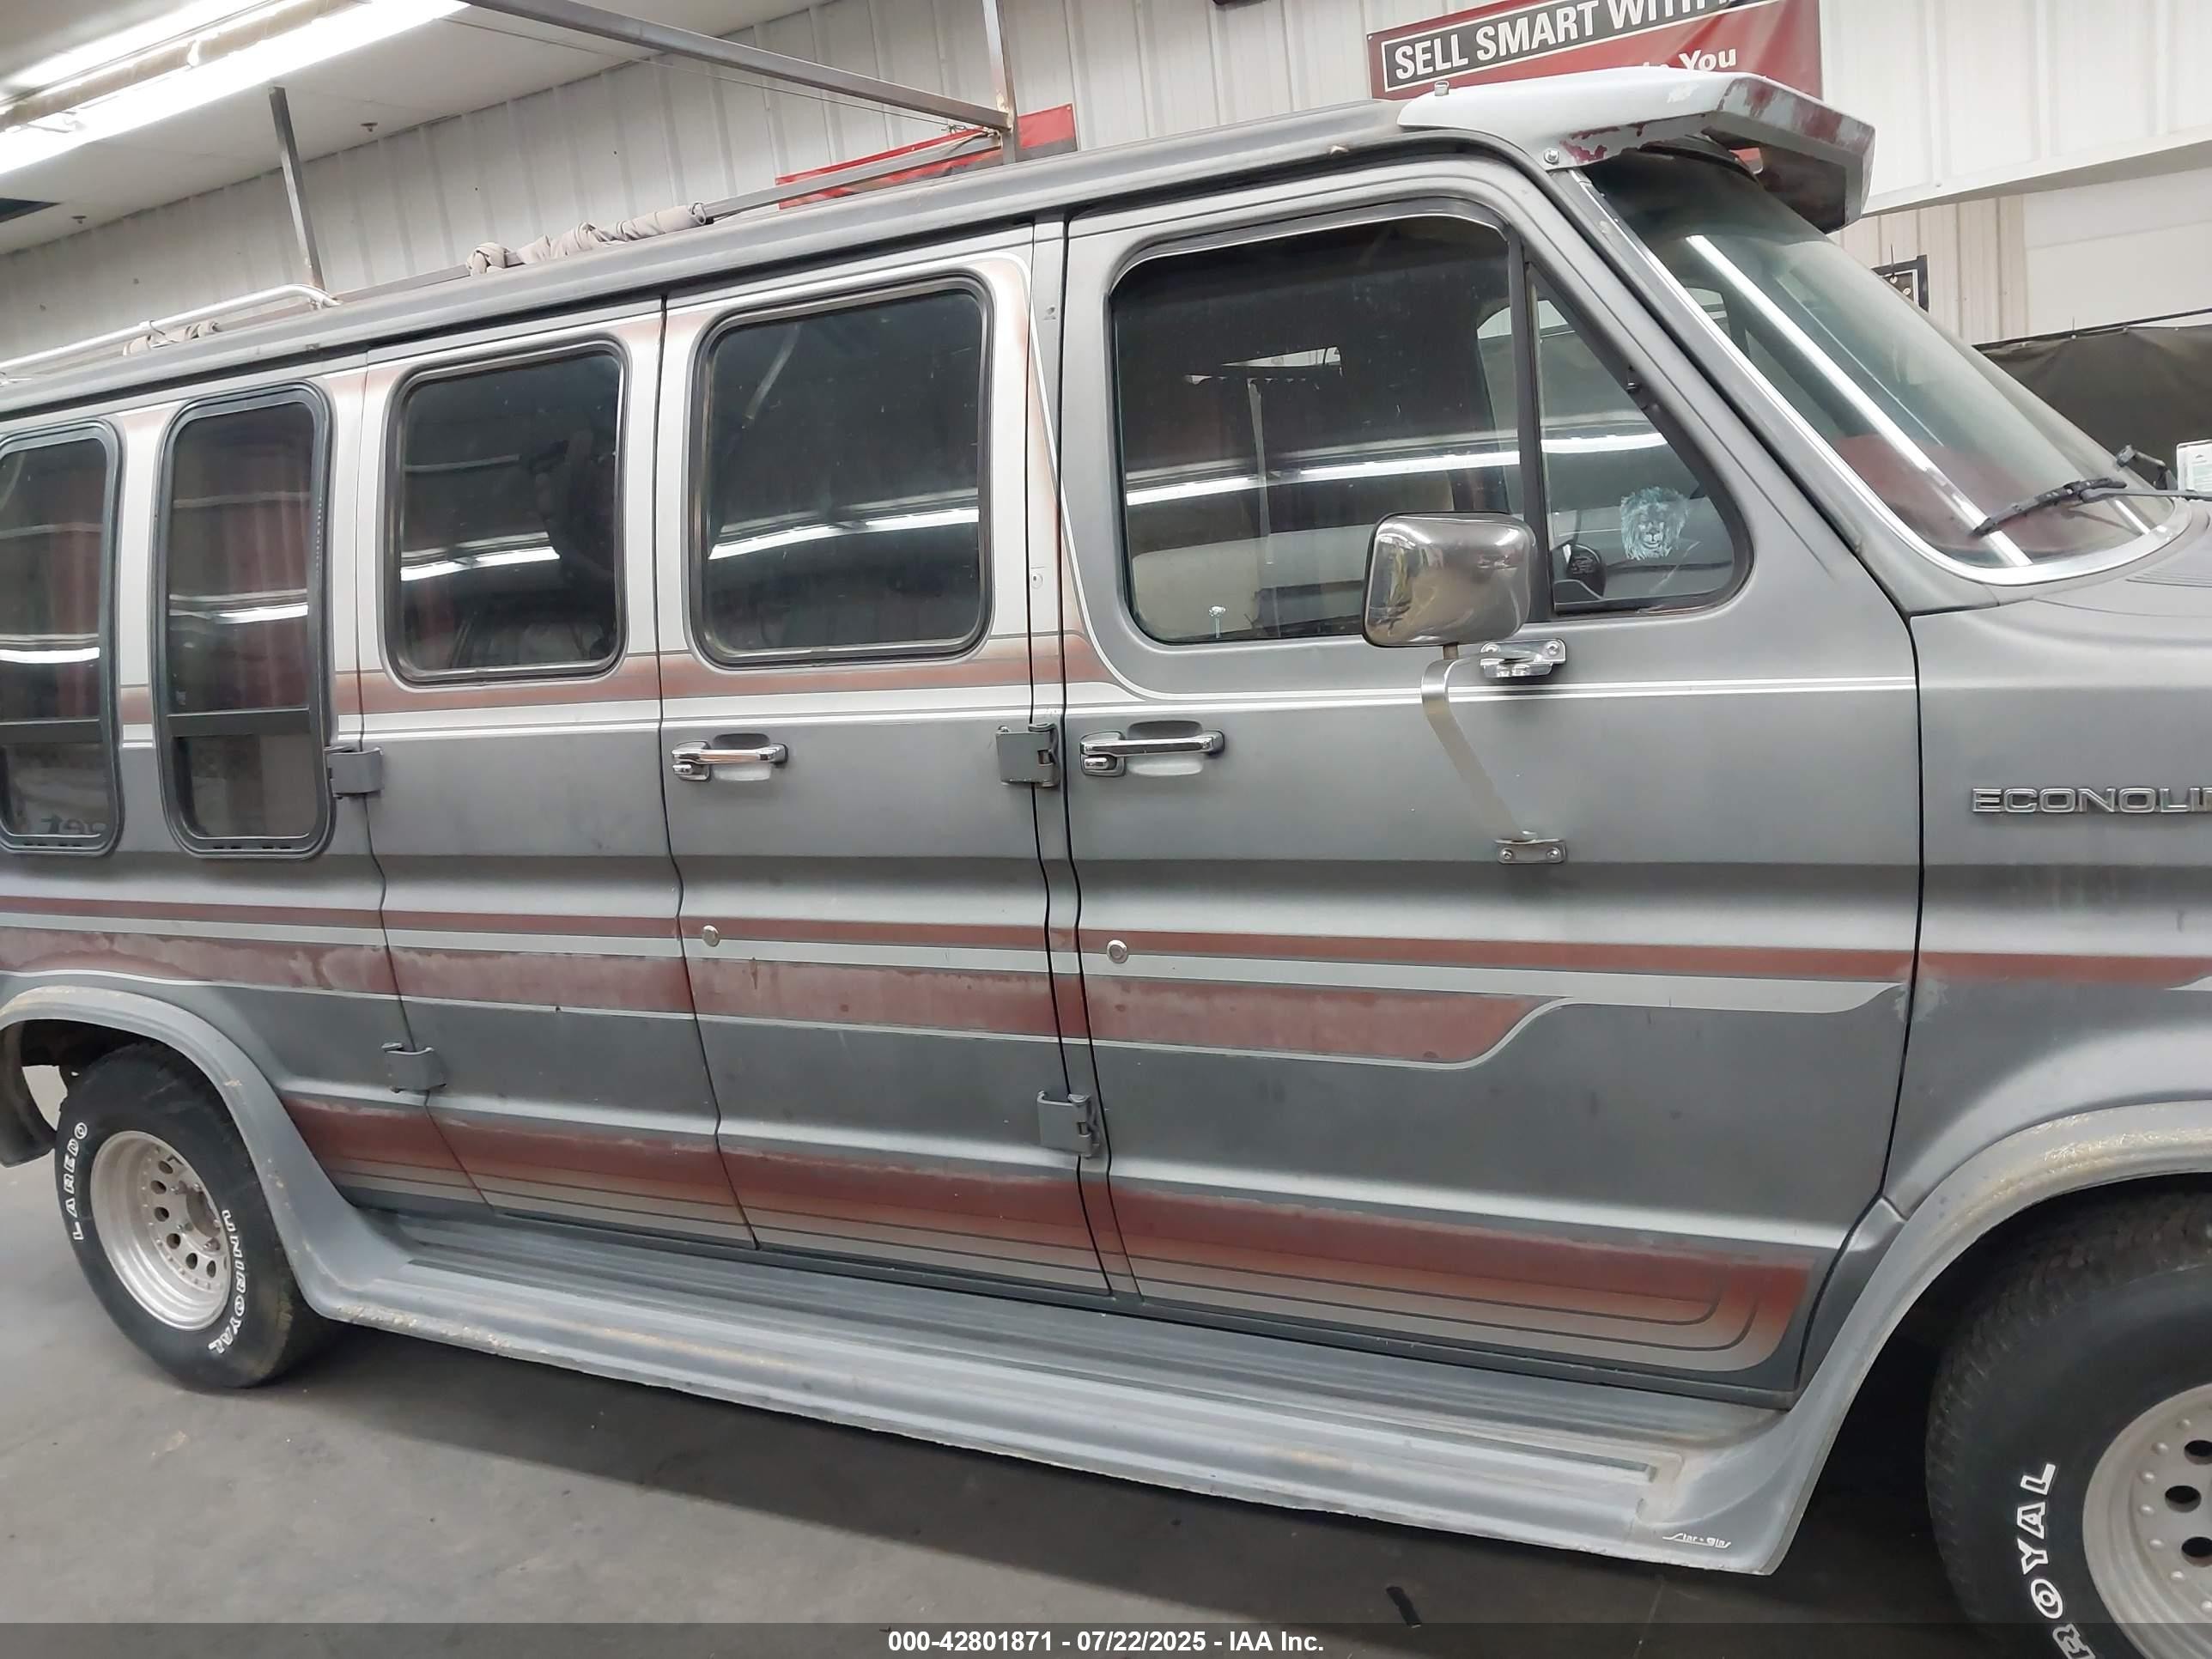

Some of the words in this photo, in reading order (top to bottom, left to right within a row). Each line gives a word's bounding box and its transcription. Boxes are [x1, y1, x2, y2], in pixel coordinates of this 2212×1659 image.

[1395, 32, 1469, 81] SELL
[1475, 0, 1599, 62] SMART
[1678, 48, 1736, 71] You
[64, 1121, 88, 1241] LAREDO
[208, 1209, 246, 1354] UNIROYAL
[2016, 1463, 2096, 1659] ROYAL
